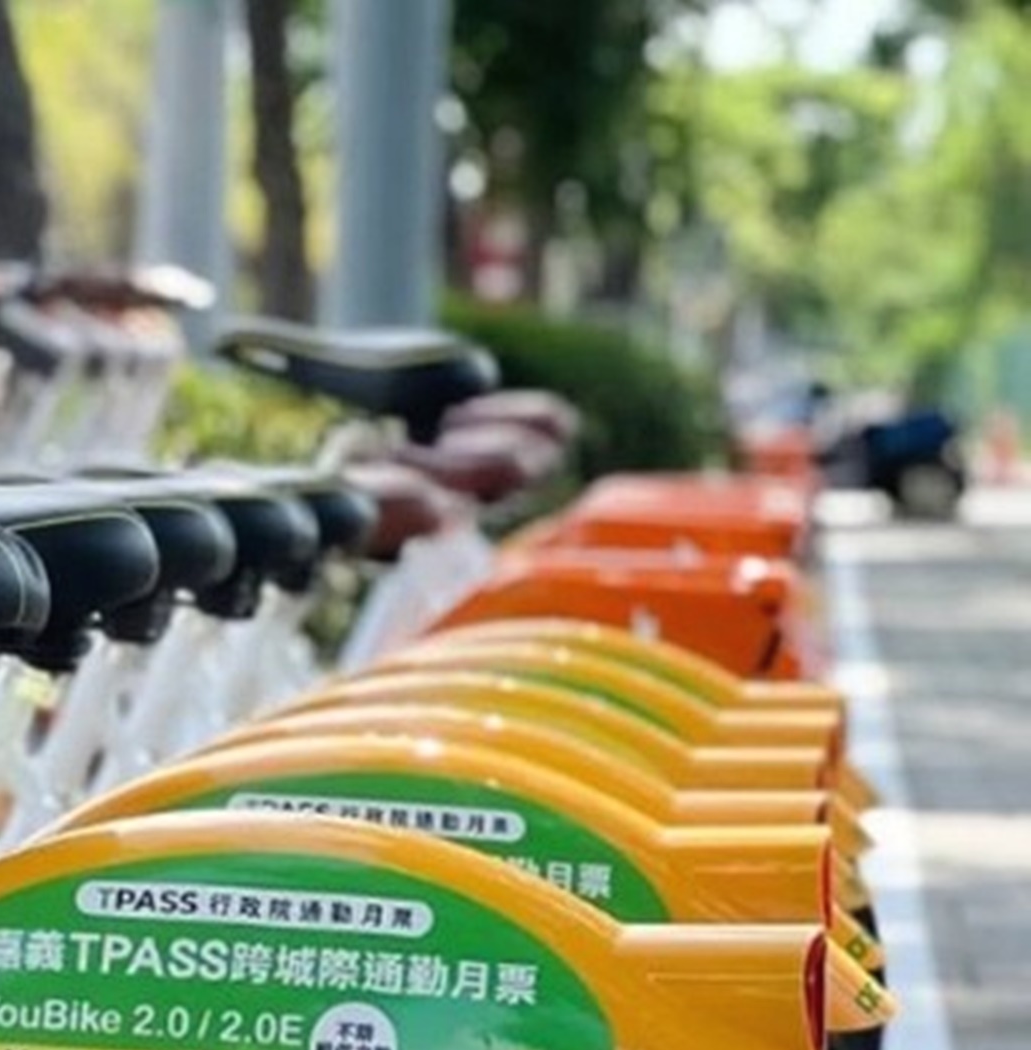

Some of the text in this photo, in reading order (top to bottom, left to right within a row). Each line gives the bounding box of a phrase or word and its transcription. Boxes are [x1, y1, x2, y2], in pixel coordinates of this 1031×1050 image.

[98, 887, 414, 929] TPASS 行政院通勤月票
[132, 1004, 190, 1039] 2.0
[219, 1010, 305, 1047] 2.0E
